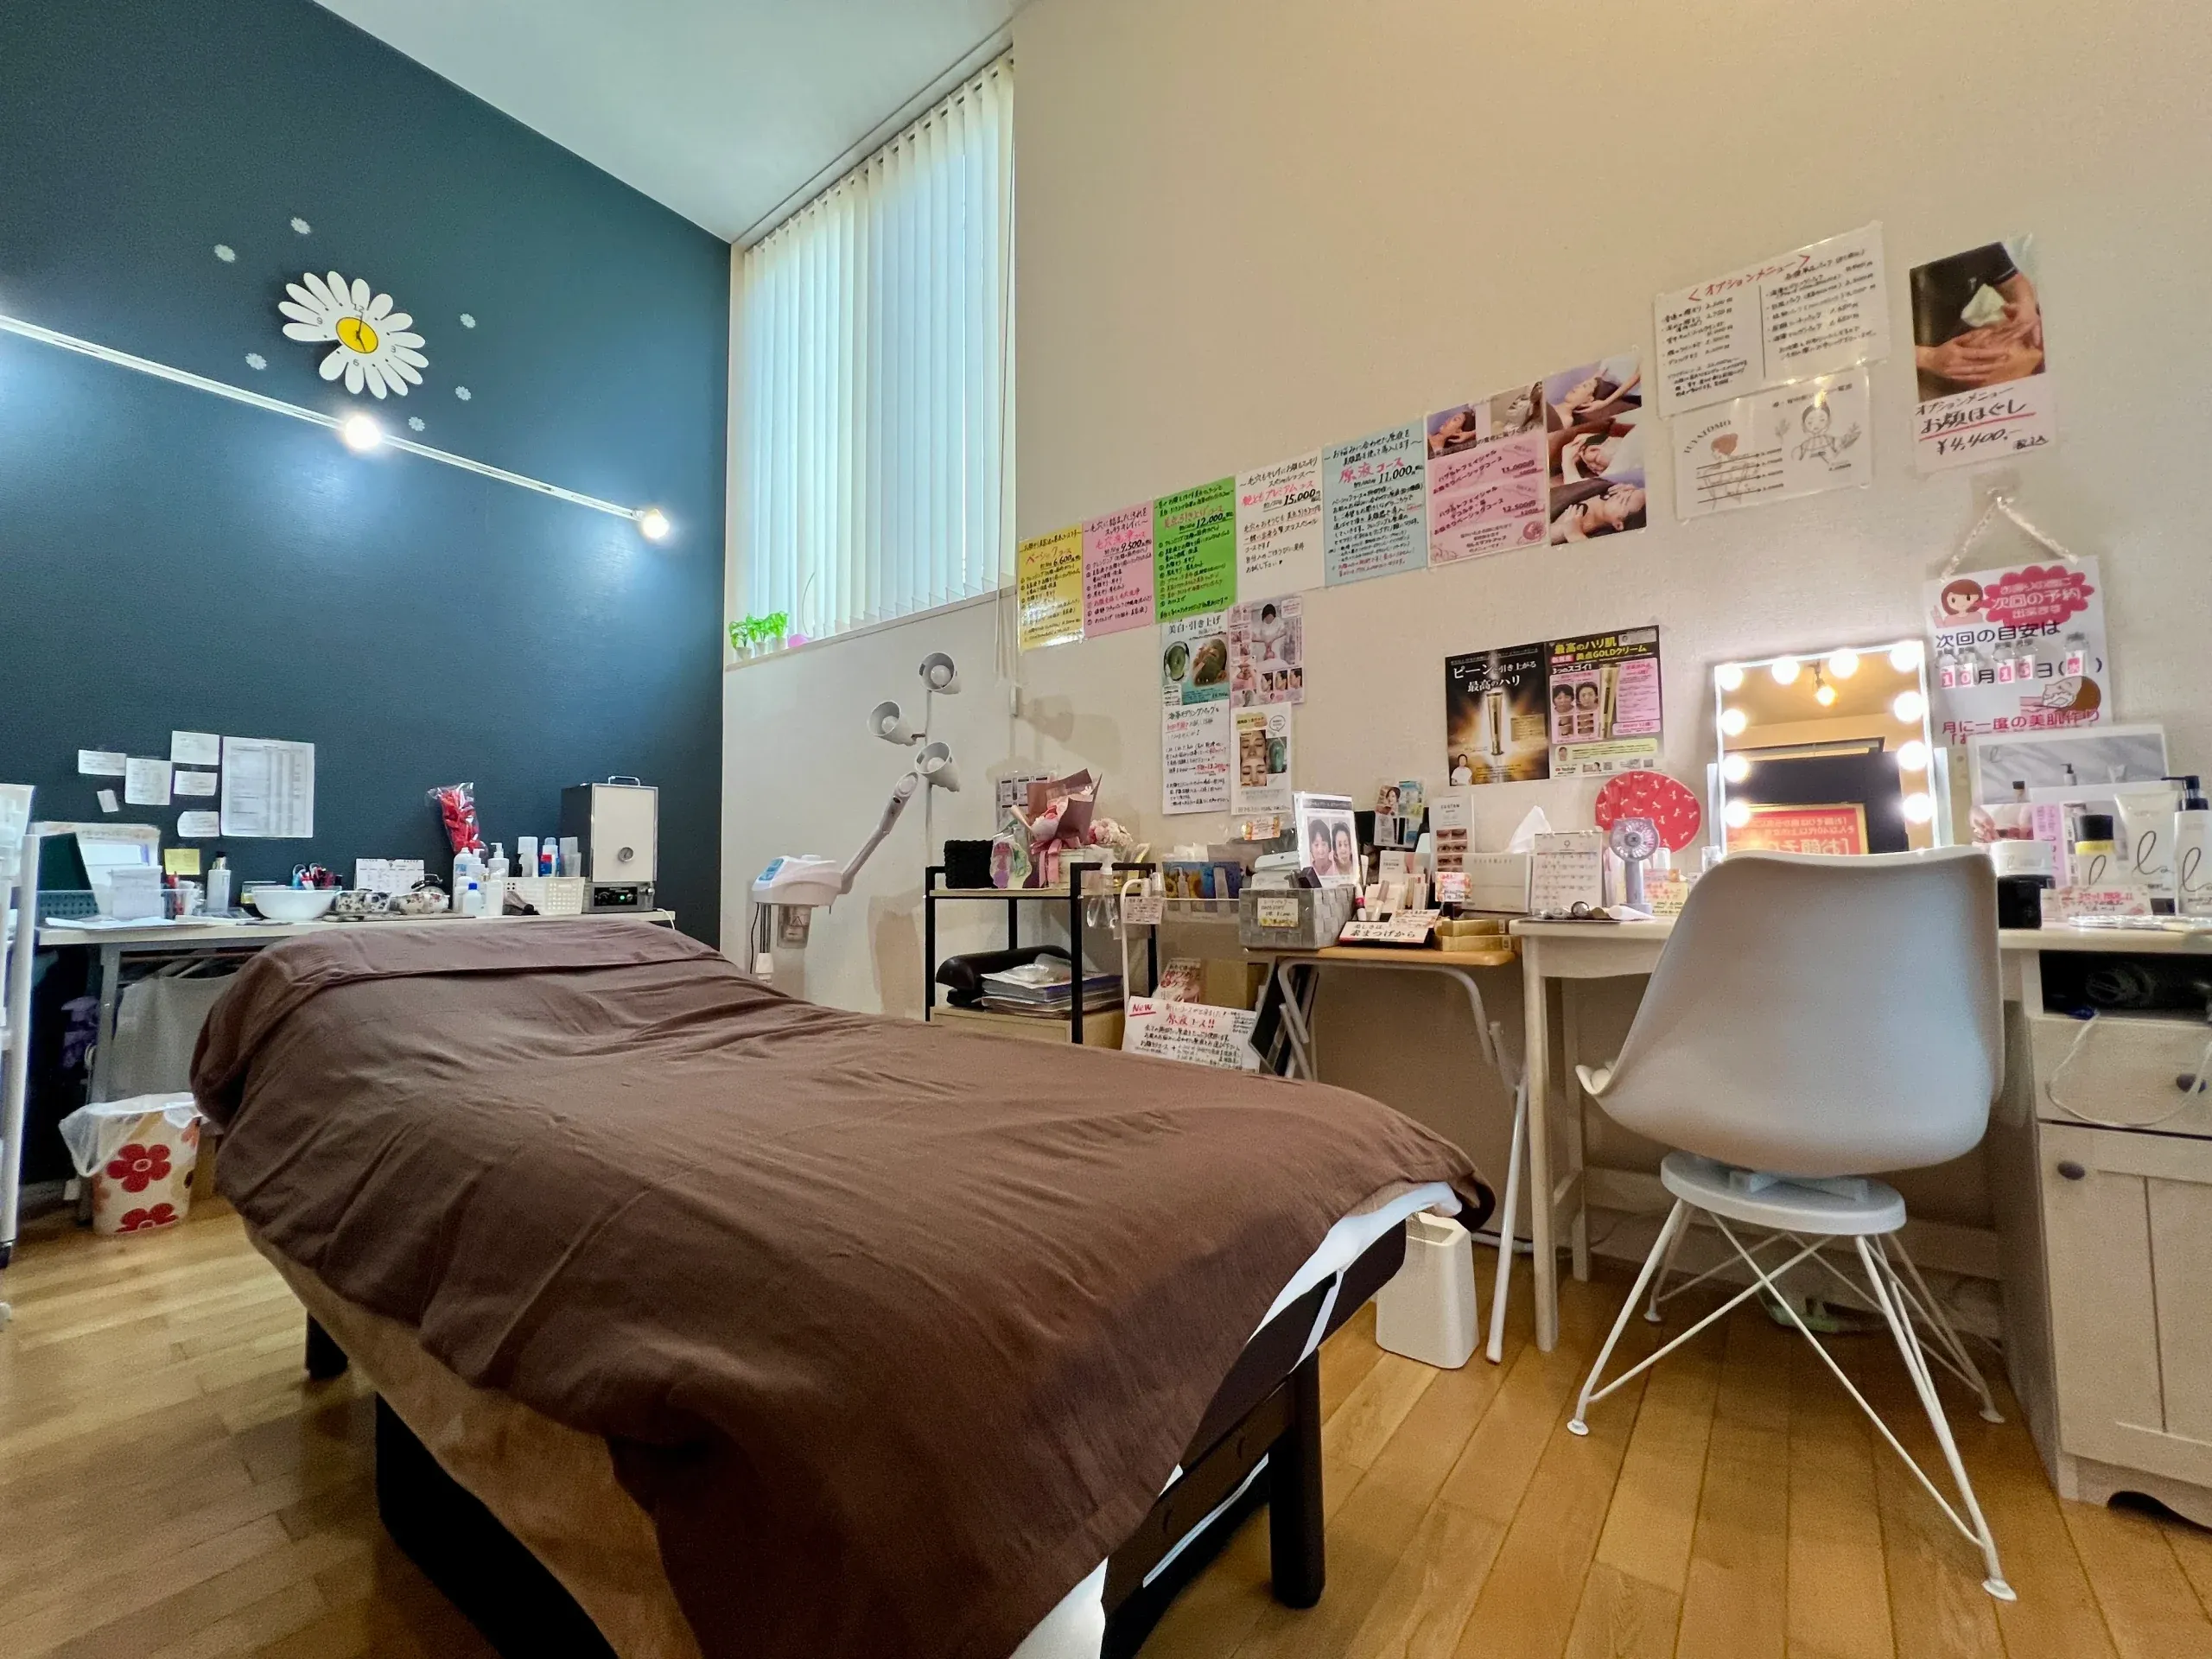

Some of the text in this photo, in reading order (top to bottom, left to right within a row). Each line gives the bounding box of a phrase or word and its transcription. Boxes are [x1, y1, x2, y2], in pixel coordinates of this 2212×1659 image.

[353, 303, 365, 312] 12
[353, 359, 359, 367] 6
[1916, 386, 2014, 416] オプションメニュー
[1339, 456, 1404, 483] 原液コース
[1990, 589, 2081, 610] 次回の予約
[2012, 605, 2062, 619] 出来ます
[1936, 621, 2061, 648] 次回の目安は
[1554, 636, 1617, 655] 最高のハリ肌
[1467, 675, 1520, 693] 最高のハリ
[1942, 710, 2100, 734] 月に一度の美肌作り
